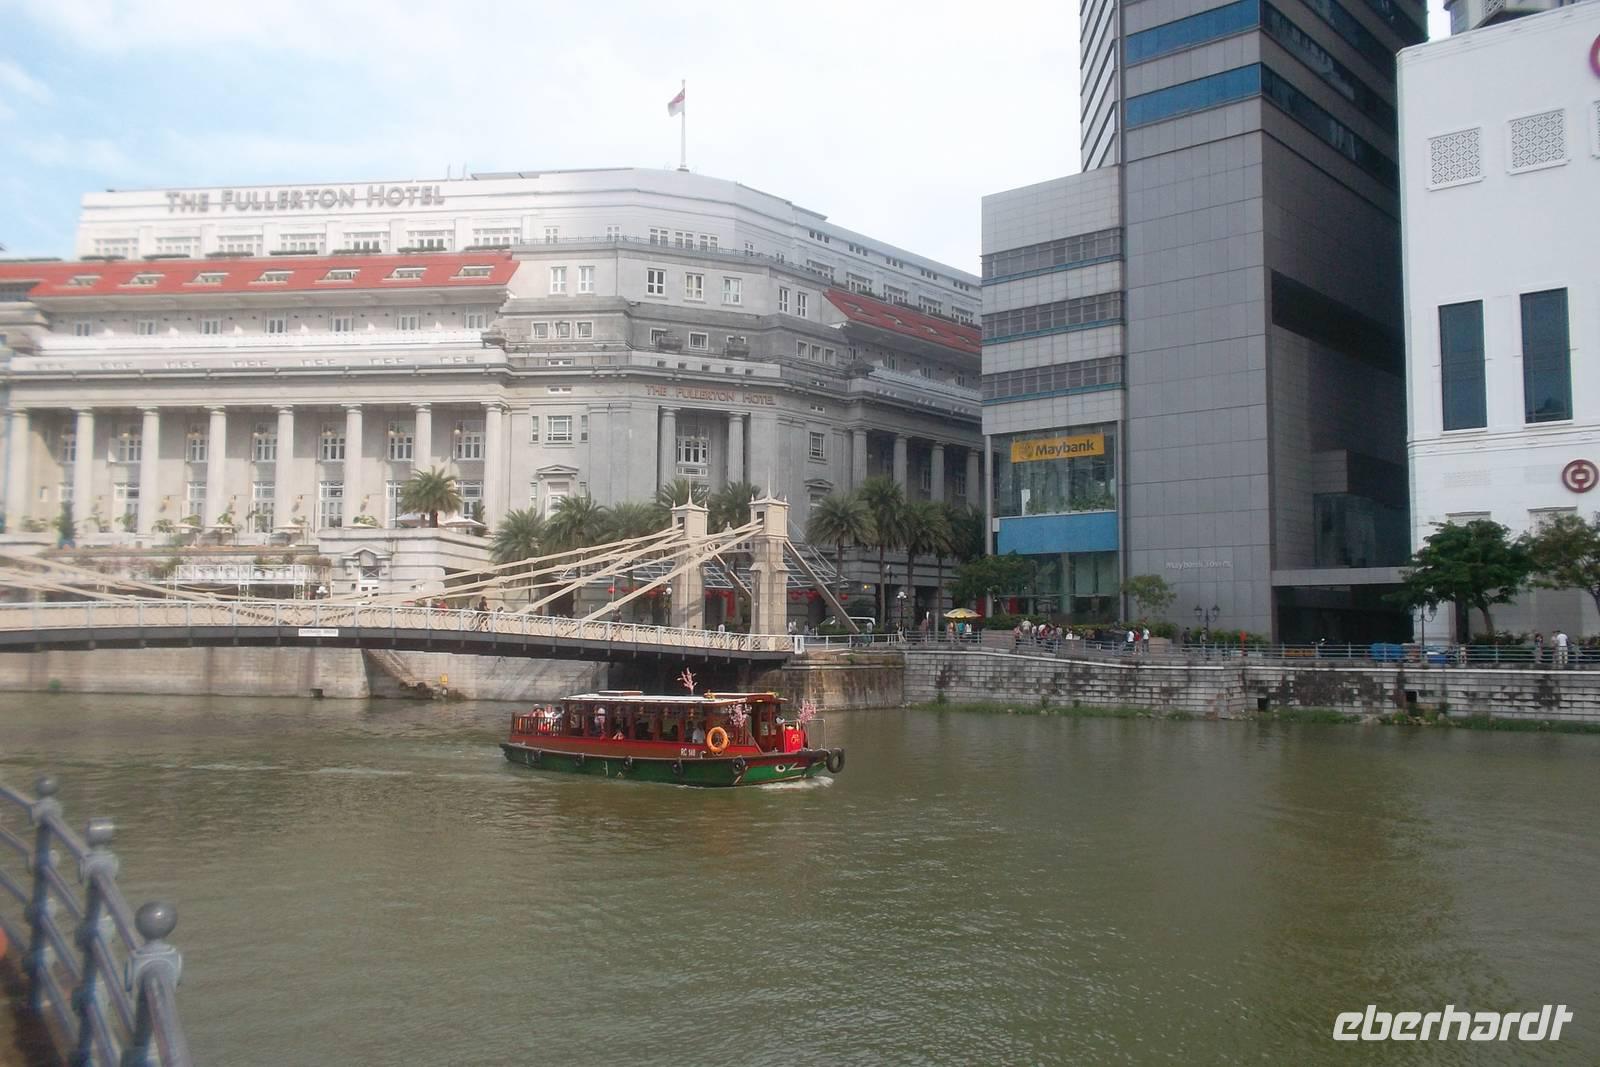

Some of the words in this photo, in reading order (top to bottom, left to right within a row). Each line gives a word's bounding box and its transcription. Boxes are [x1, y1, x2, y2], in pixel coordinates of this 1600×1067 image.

[165, 190, 209, 213] THE
[220, 188, 356, 211] FULLERTON
[366, 184, 446, 207] HOTEL
[645, 384, 667, 397] THE
[676, 386, 737, 402] FULLERTON
[742, 391, 777, 406] HOTEL
[1035, 439, 1095, 457] Maybank
